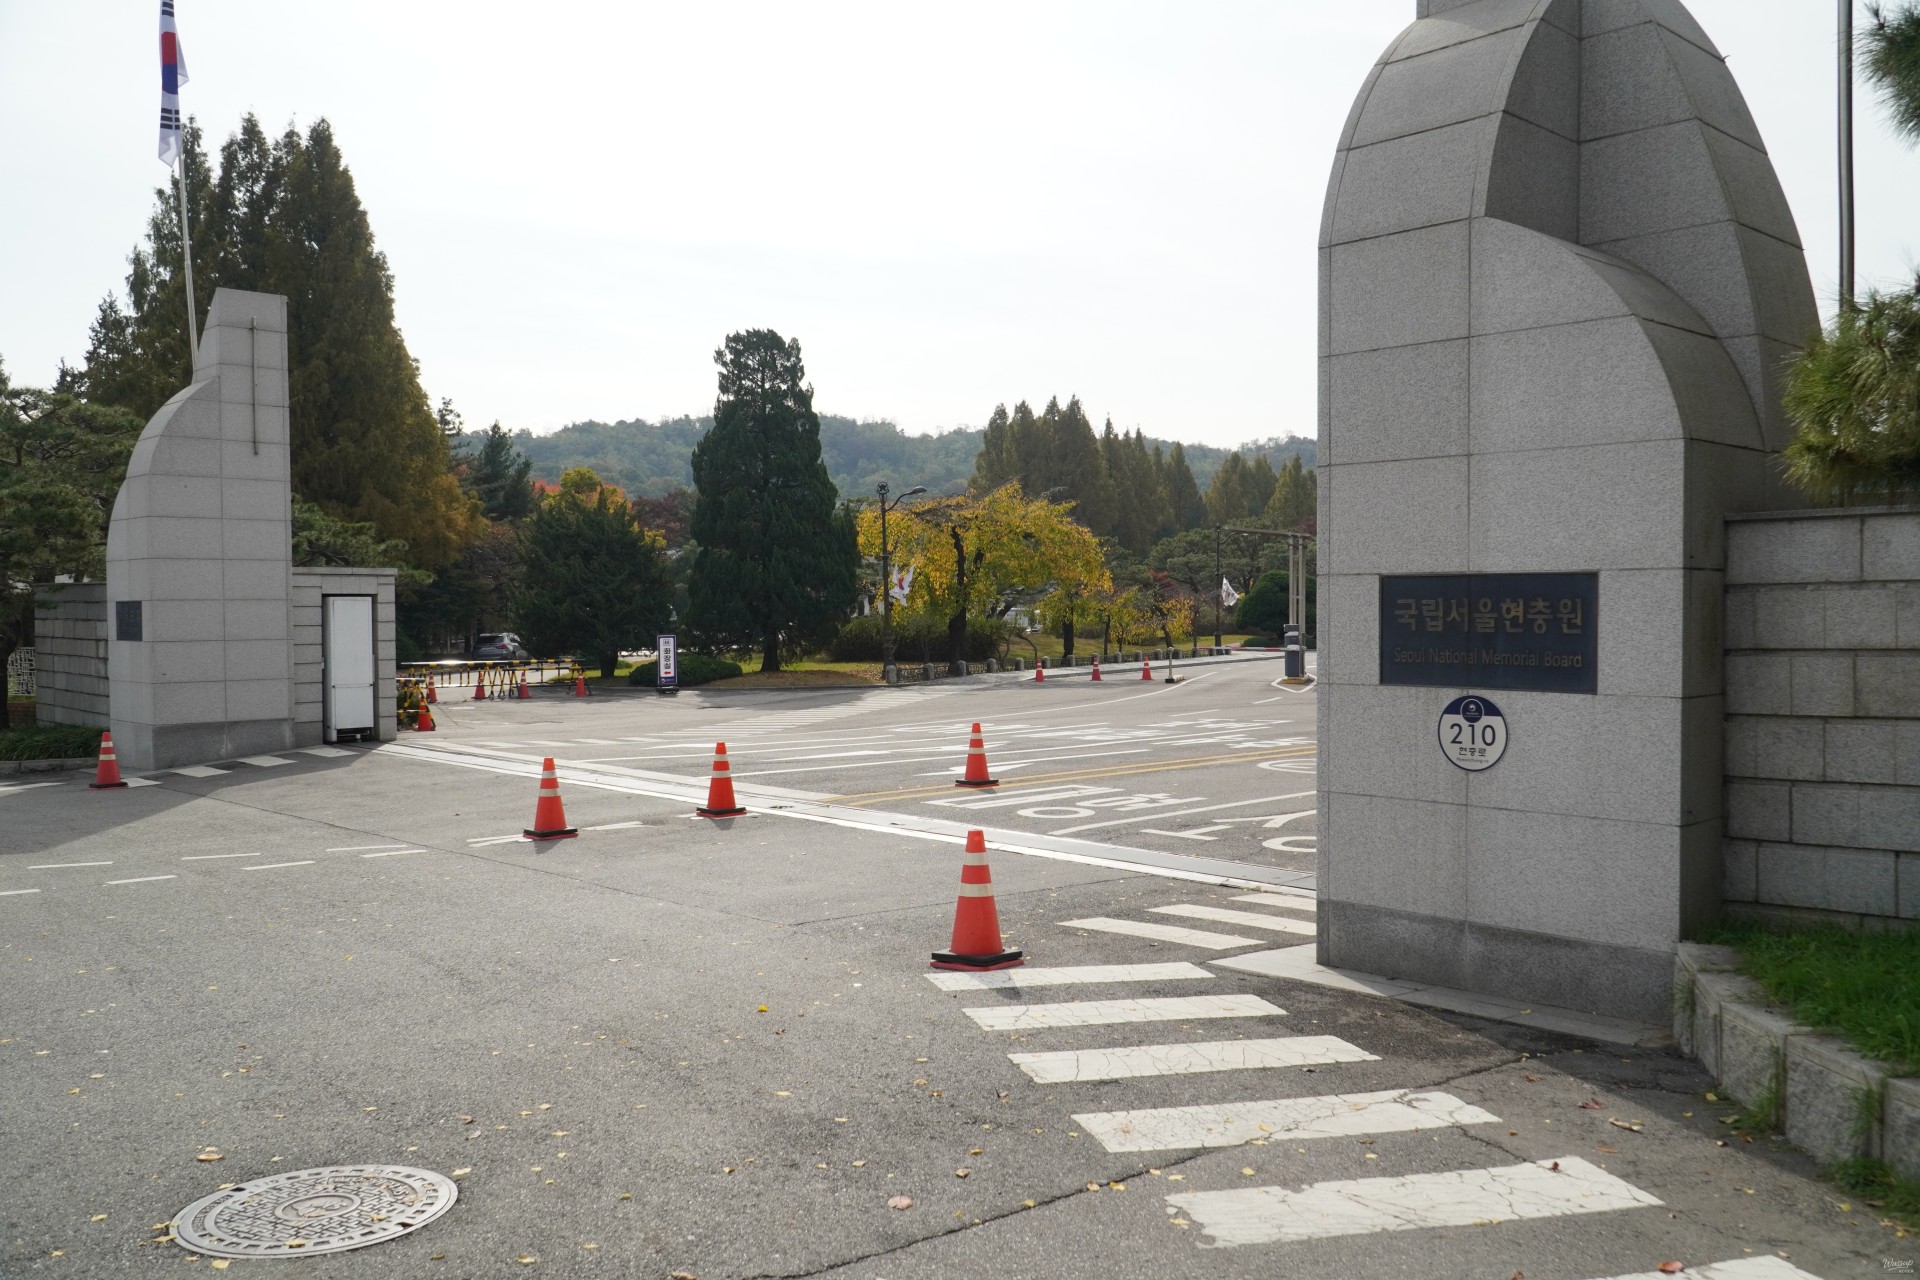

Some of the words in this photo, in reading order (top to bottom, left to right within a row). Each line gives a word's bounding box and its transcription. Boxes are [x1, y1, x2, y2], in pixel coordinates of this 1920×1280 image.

[1394, 597, 1583, 635] 국립서울현충원
[1393, 647, 1425, 663] Seoul
[1429, 648, 1477, 665] National
[1481, 649, 1539, 667] Memorial
[1544, 651, 1583, 668] Board
[1450, 723, 1496, 747] 210
[1459, 746, 1487, 757] 현충로
